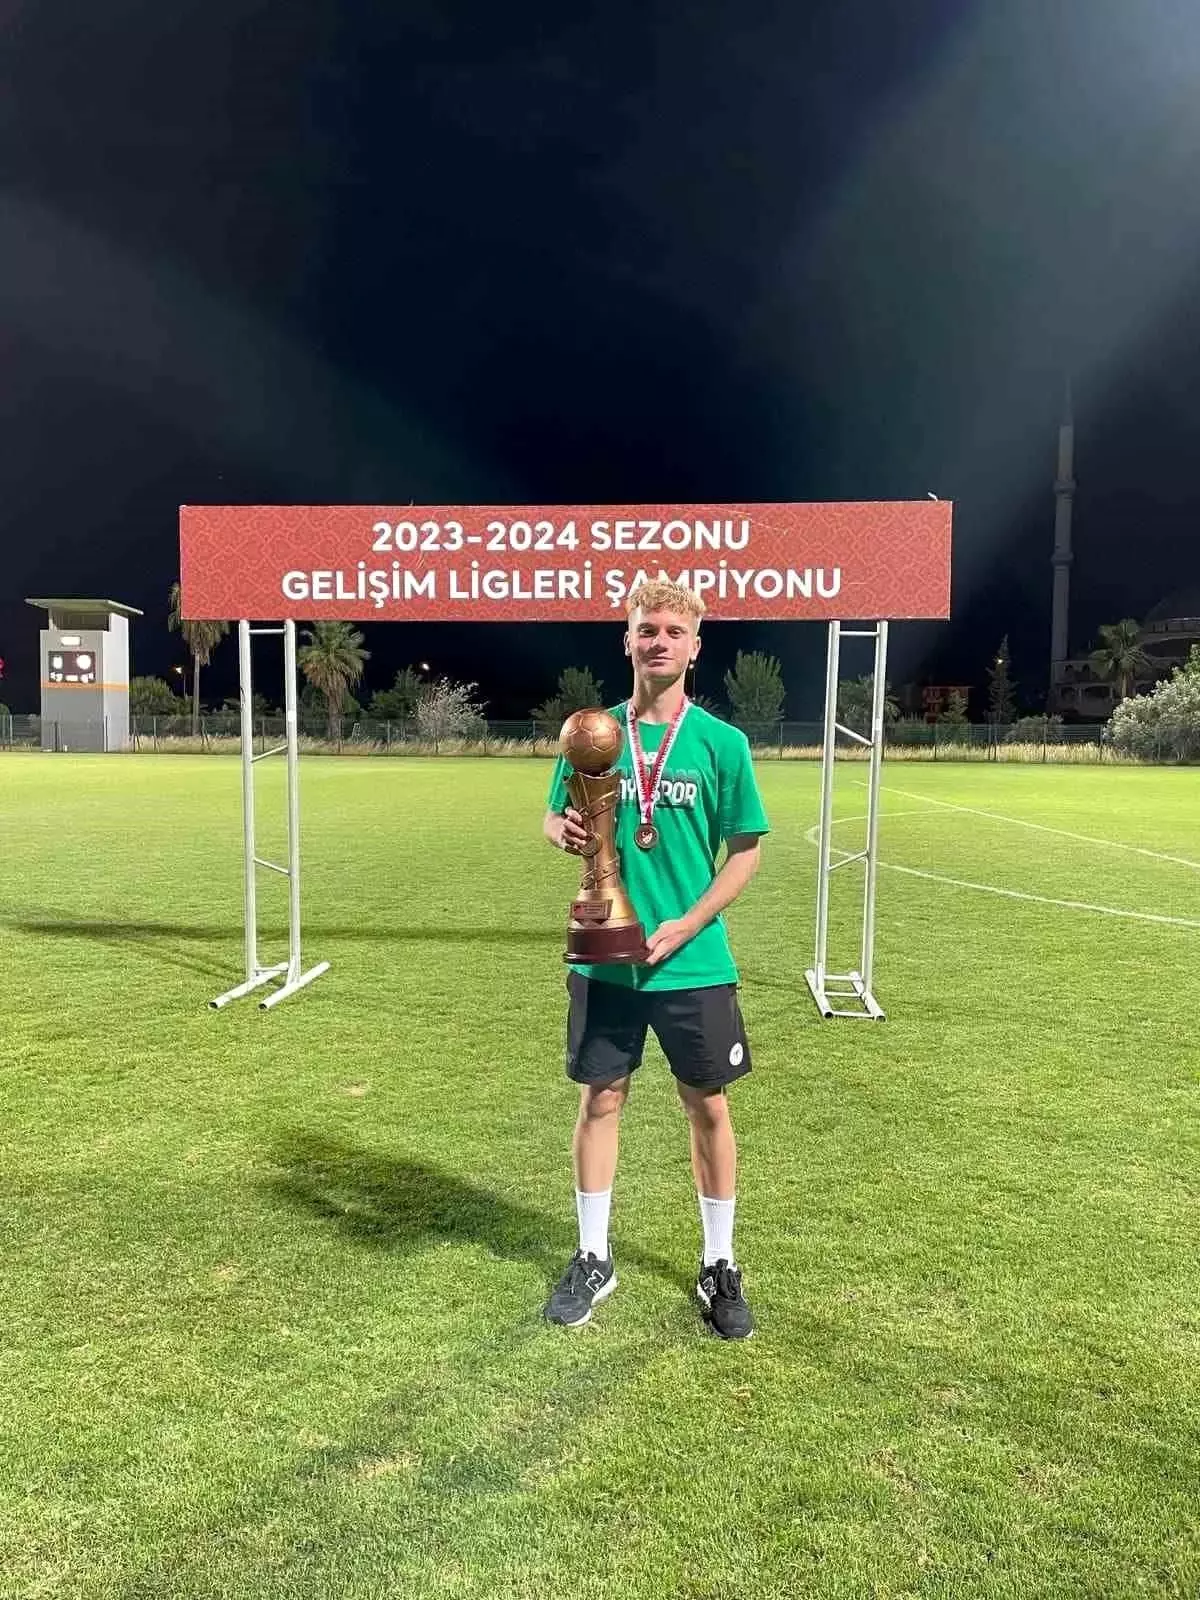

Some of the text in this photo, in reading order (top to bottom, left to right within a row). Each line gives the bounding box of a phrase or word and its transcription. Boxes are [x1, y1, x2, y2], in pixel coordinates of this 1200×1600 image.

[371, 520, 750, 551] 2023-2024 SEZONU
[281, 560, 436, 609] GELİŞİM
[449, 559, 592, 600] LİGLERİ
